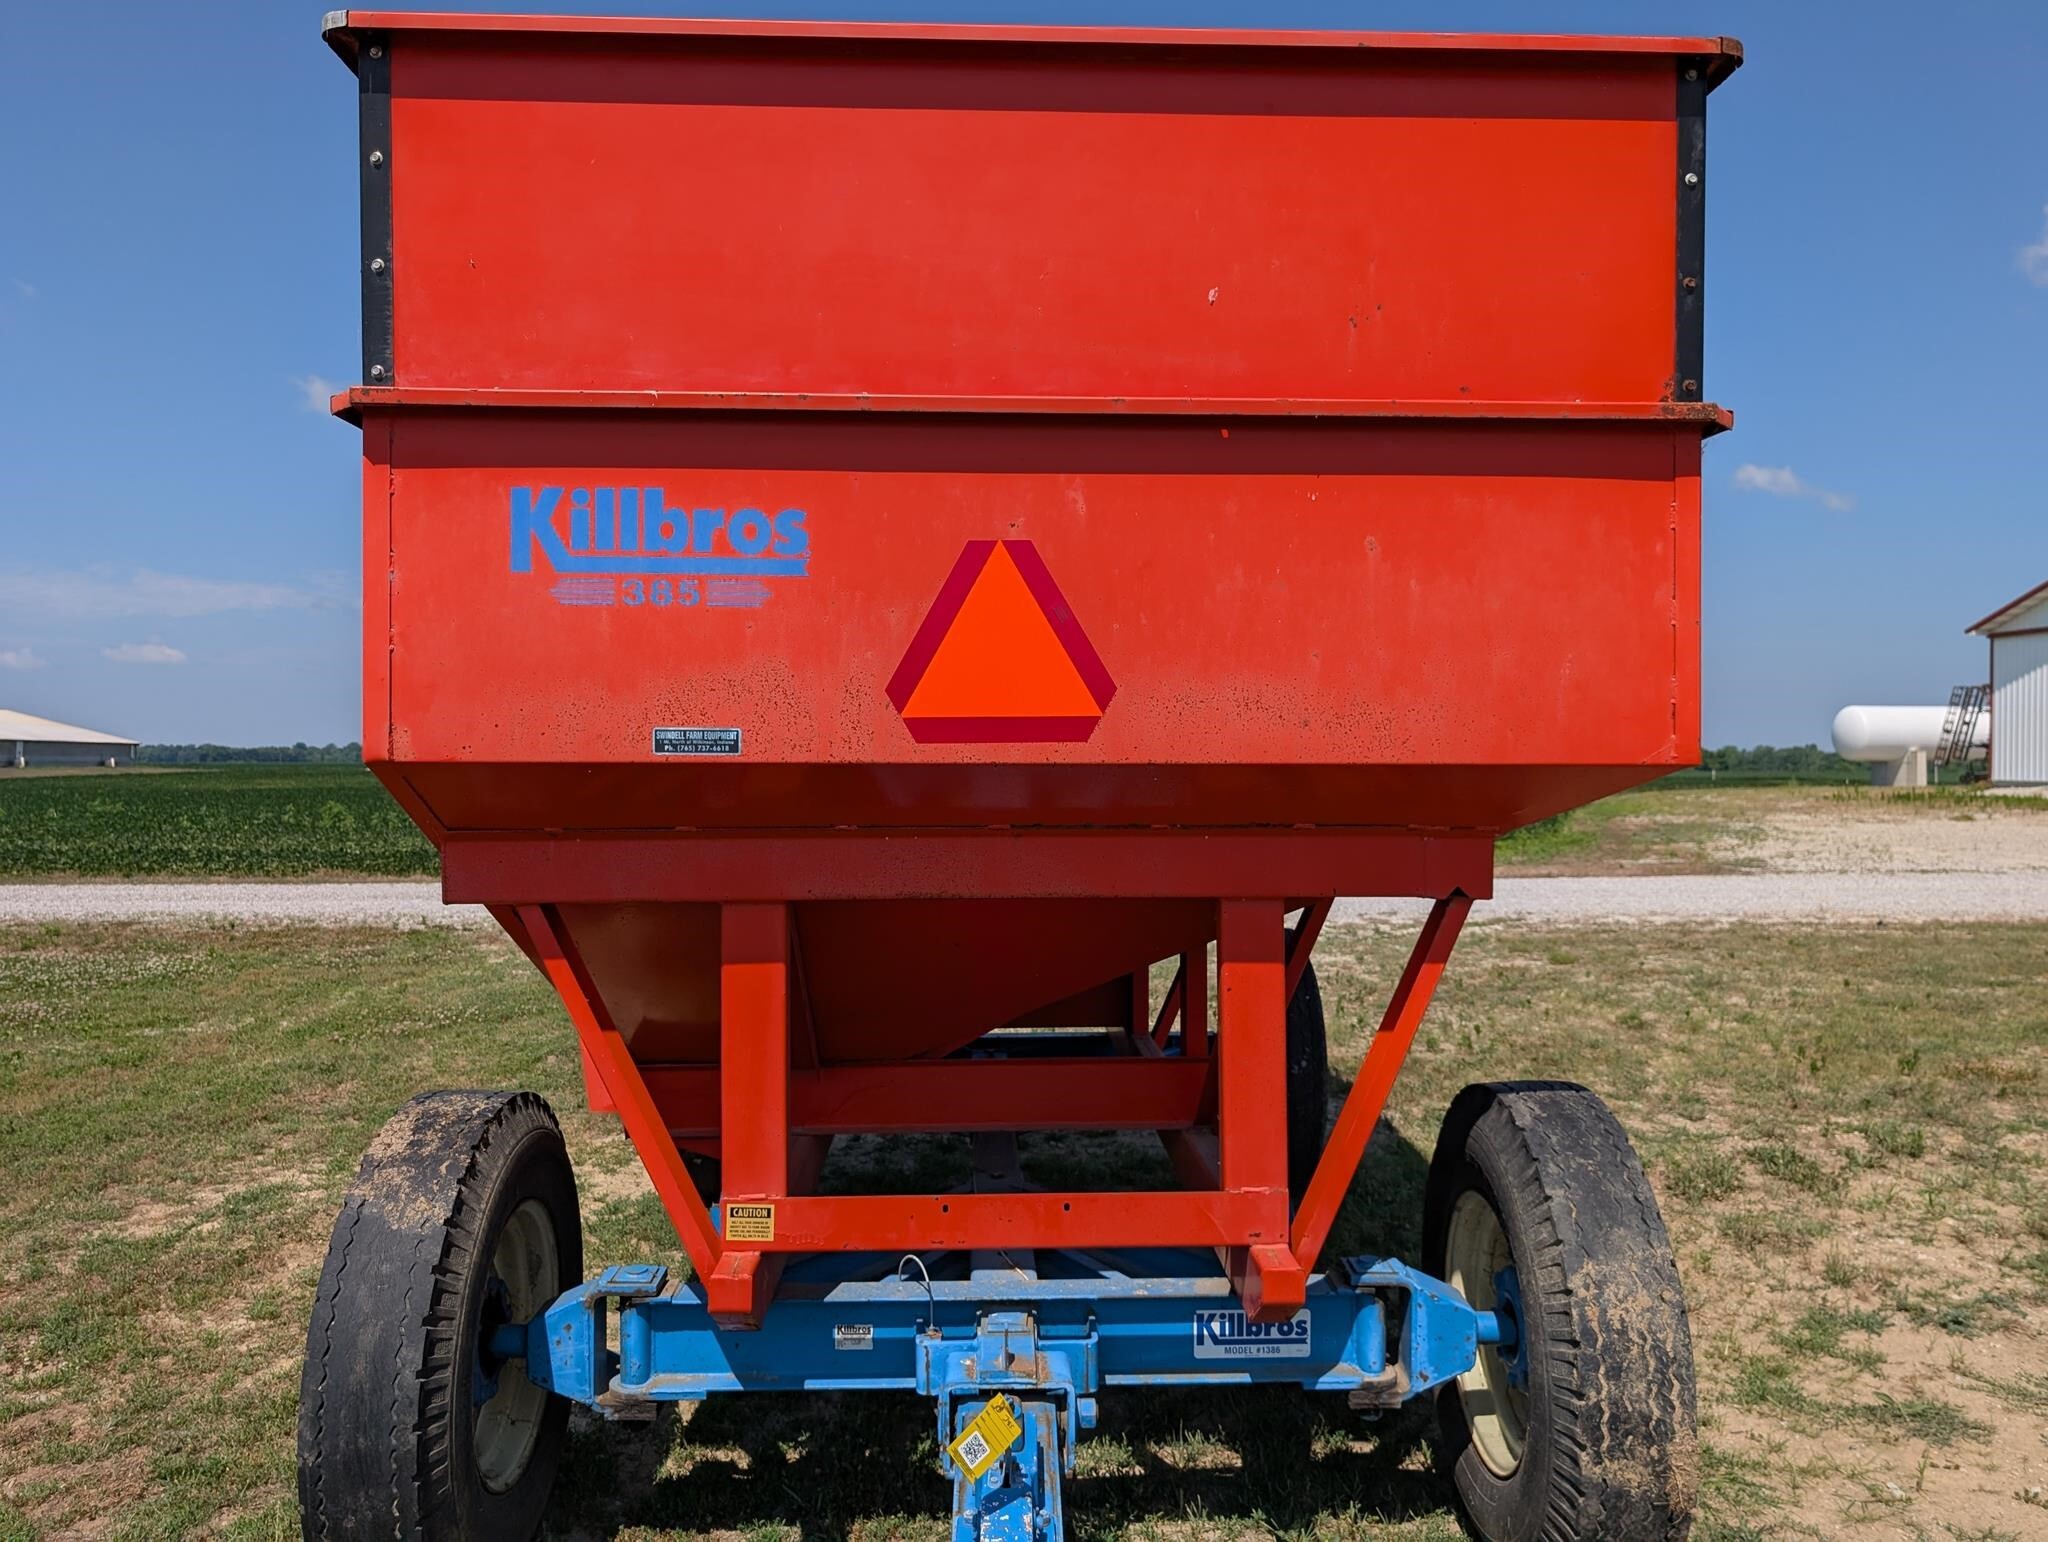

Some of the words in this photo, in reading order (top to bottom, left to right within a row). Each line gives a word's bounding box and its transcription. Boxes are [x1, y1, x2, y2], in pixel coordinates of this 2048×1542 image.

[509, 486, 809, 576] Killbros
[621, 578, 700, 607] 385
[656, 730, 685, 740] SWINDELL
[686, 731, 702, 740] FARM
[704, 731, 737, 740] EQUIPMENT
[733, 1208, 768, 1218] CAUTION
[836, 1324, 872, 1336] Killbros
[1196, 1312, 1309, 1346] Killbros
[1224, 1346, 1253, 1355] MODEL
[1256, 1346, 1281, 1354] #1386
